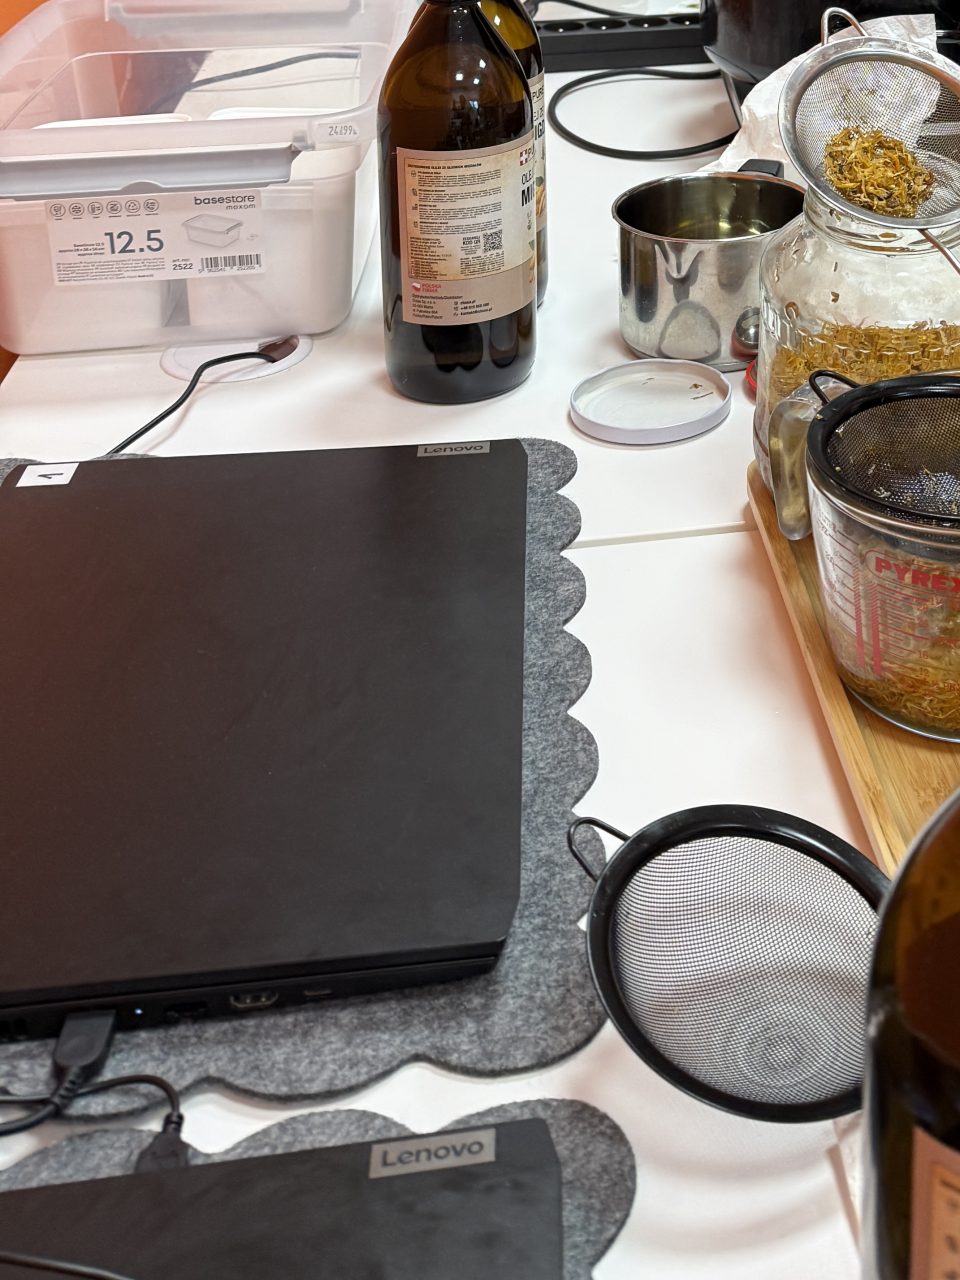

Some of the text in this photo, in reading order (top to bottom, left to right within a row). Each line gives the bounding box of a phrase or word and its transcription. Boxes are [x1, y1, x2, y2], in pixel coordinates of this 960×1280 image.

[193, 195, 256, 206] basestore
[104, 229, 165, 255] 12.5
[172, 263, 194, 271] 2522
[423, 445, 484, 454] Lenovo
[382, 1140, 484, 1167] Lenovo
